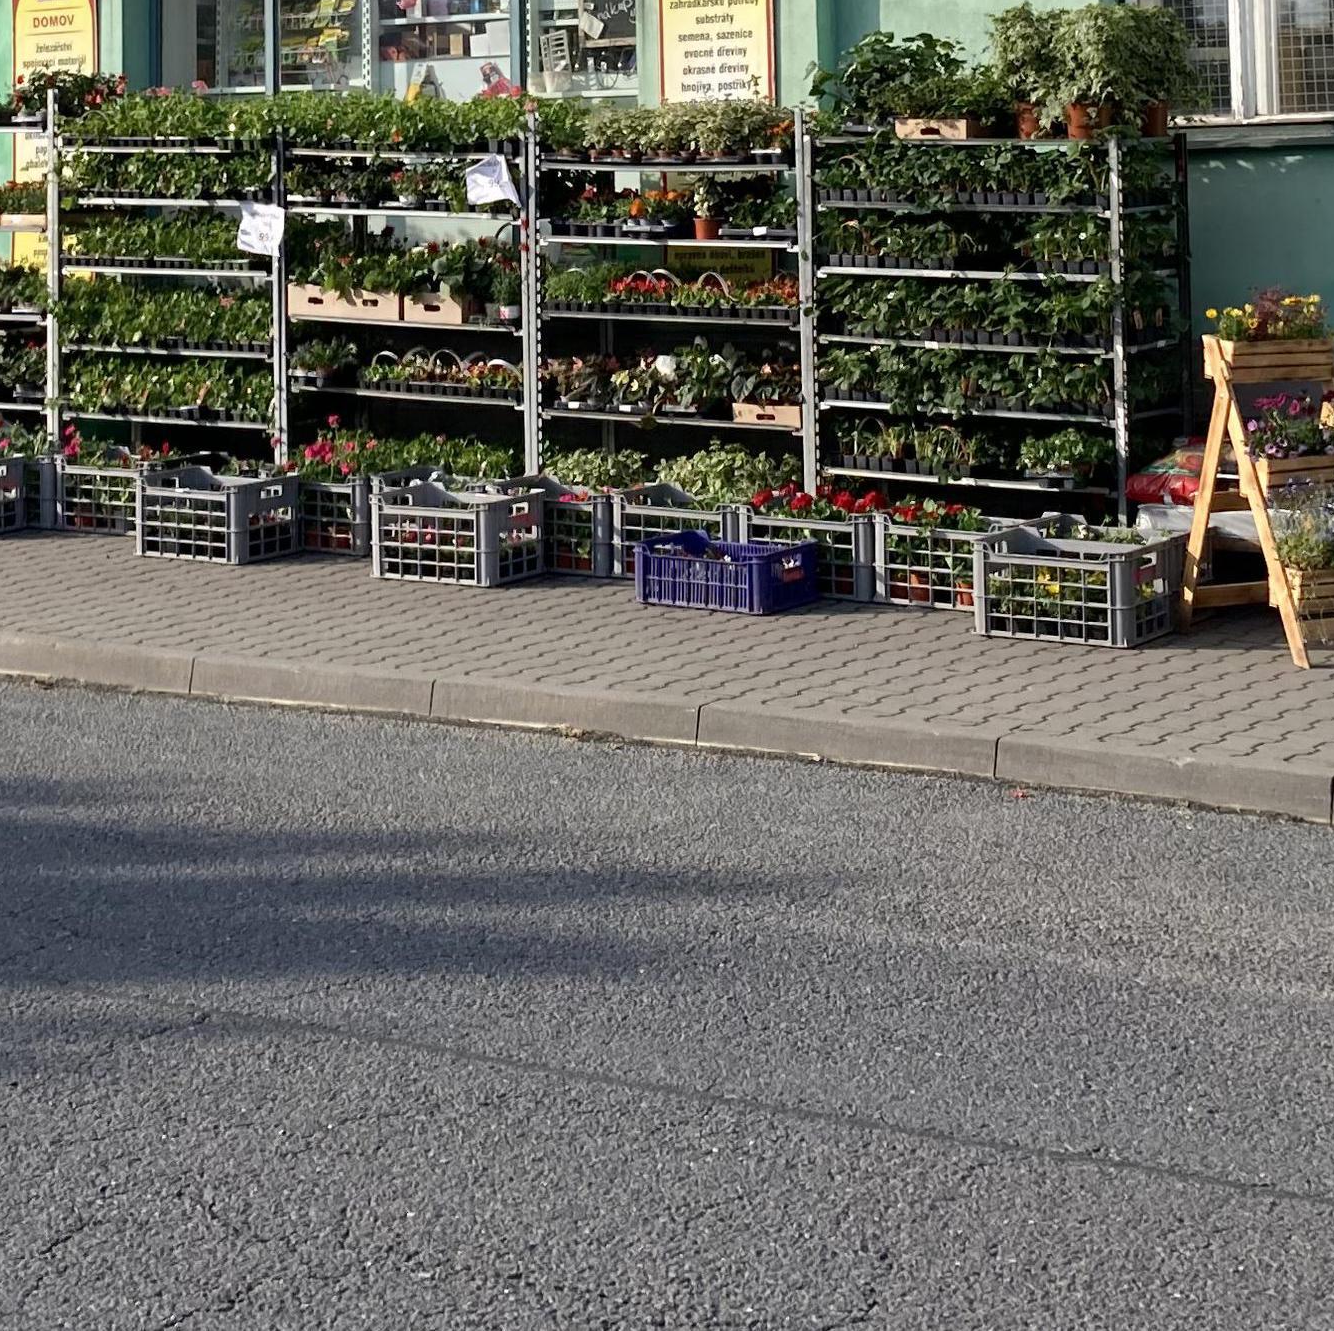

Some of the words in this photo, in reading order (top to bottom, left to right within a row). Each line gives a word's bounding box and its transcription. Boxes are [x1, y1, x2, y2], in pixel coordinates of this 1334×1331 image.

[32, 14, 75, 28] DOMOV
[695, 13, 734, 25] substráty
[677, 32, 713, 43] semena,
[716, 28, 754, 40] sazenice
[683, 48, 714, 59] ovocné
[716, 46, 748, 58] dřeviny
[682, 64, 716, 76] okrasné
[718, 63, 750, 75] dřeviny
[717, 78, 752, 93] postřiky
